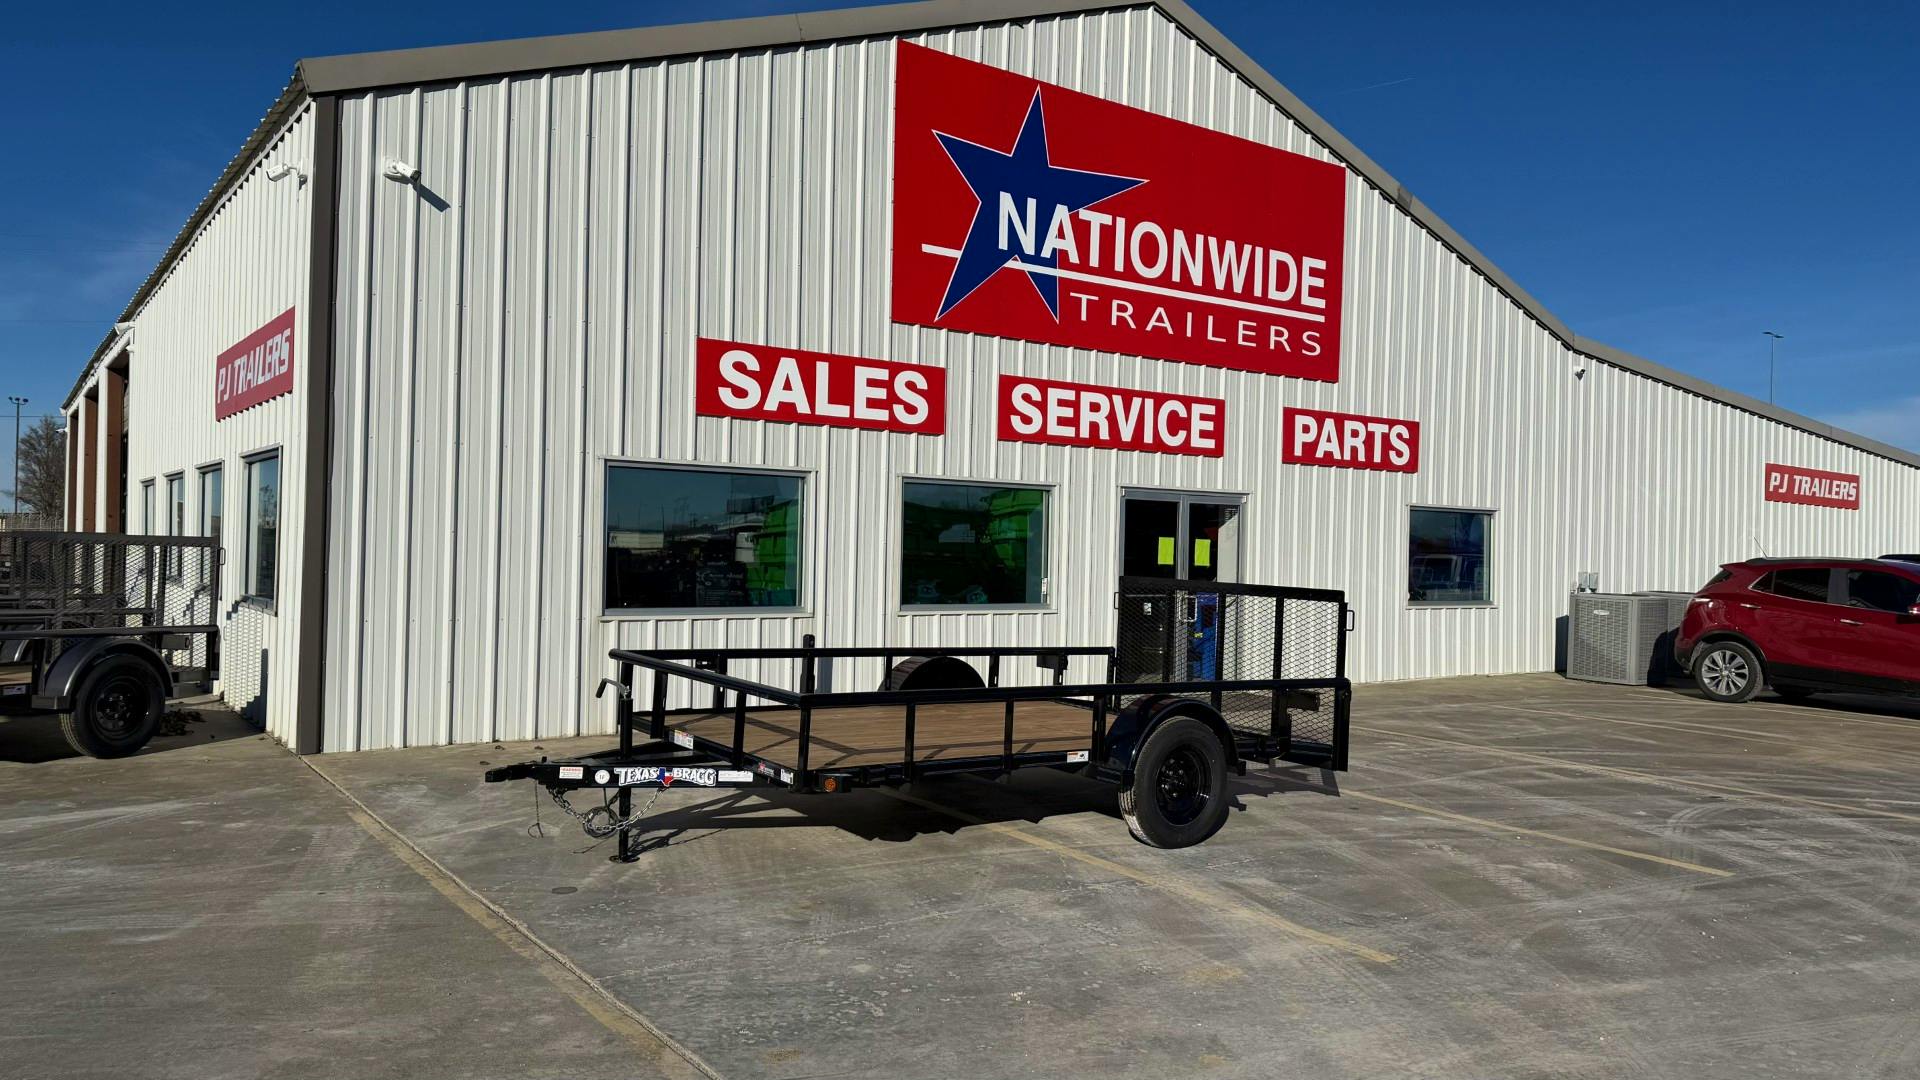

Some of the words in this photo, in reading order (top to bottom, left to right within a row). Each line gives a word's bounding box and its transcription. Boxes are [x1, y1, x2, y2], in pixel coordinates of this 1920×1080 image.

[999, 191, 1326, 309] NATIONWIDE
[1070, 292, 1321, 356] TRAILERS
[217, 363, 231, 404] PJ
[233, 327, 291, 397] TRAILERS
[718, 350, 929, 425] SALES
[1010, 383, 1216, 449] SERVICE
[1294, 414, 1410, 466] PARTS
[1769, 472, 1789, 494] PJ
[1793, 475, 1857, 501] TRAILERS
[614, 767, 659, 786] TEXAS
[672, 767, 716, 786] BRAGG
